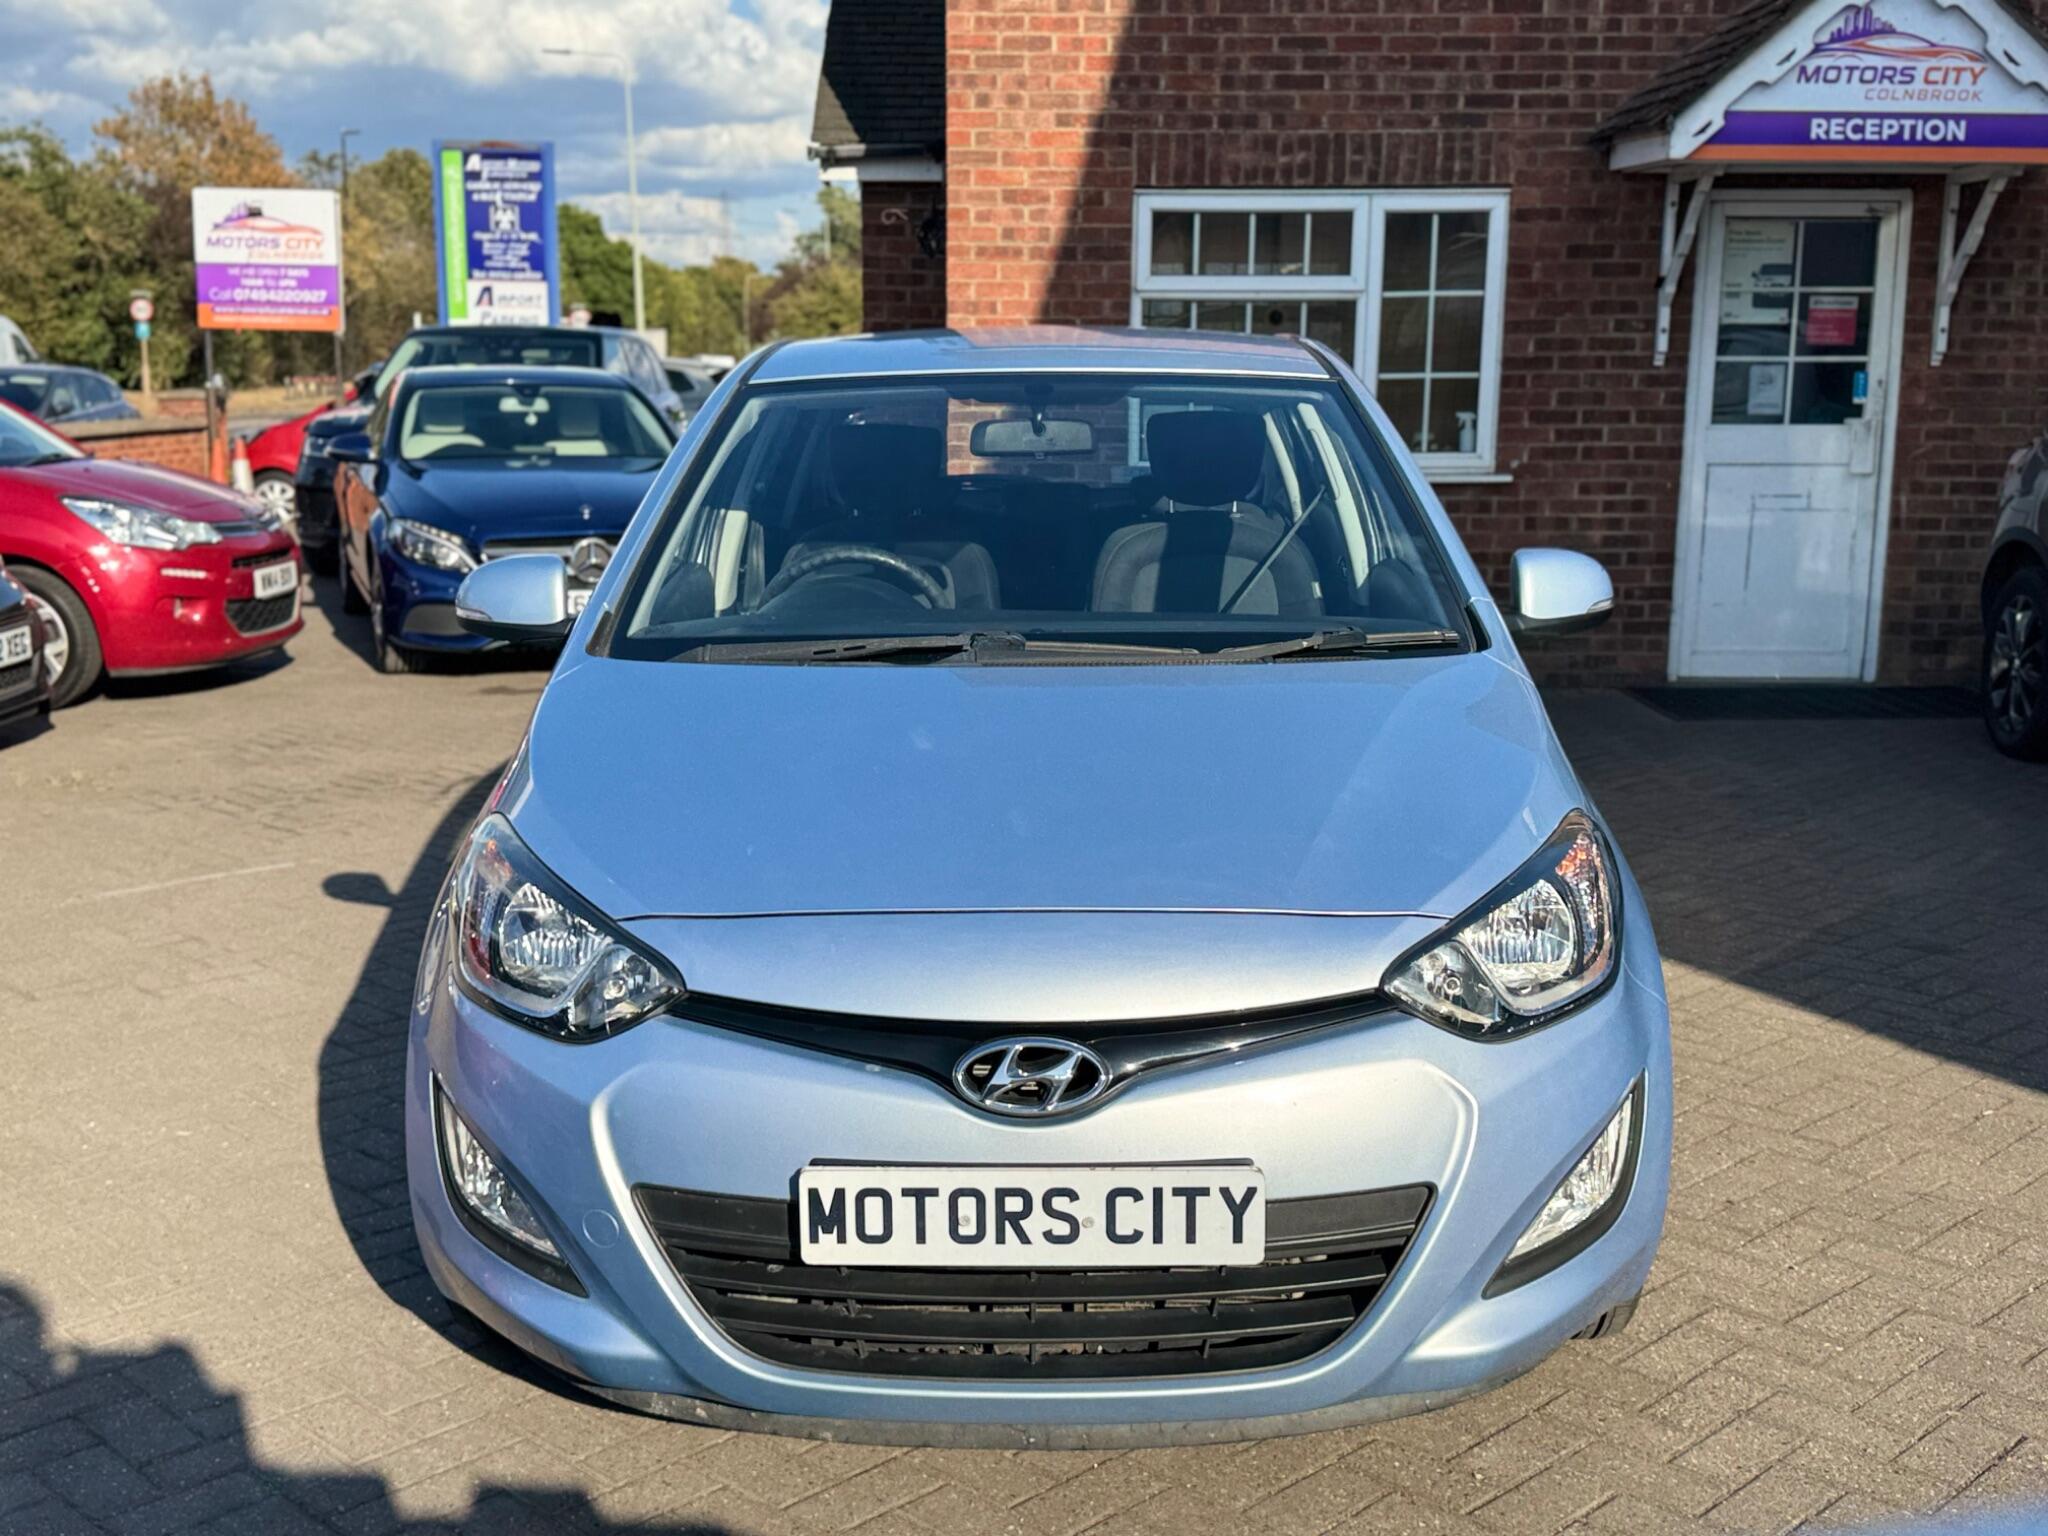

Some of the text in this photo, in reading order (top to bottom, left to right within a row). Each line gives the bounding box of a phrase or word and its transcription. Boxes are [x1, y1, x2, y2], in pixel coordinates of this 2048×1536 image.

[1797, 66, 1987, 85] MOTORS CITY
[1864, 88, 1983, 102] COLNBROOK
[1810, 118, 1967, 142] RECEPTION
[207, 234, 323, 250] MOTORS CITY
[808, 1186, 1258, 1245] MOTORS CITY
